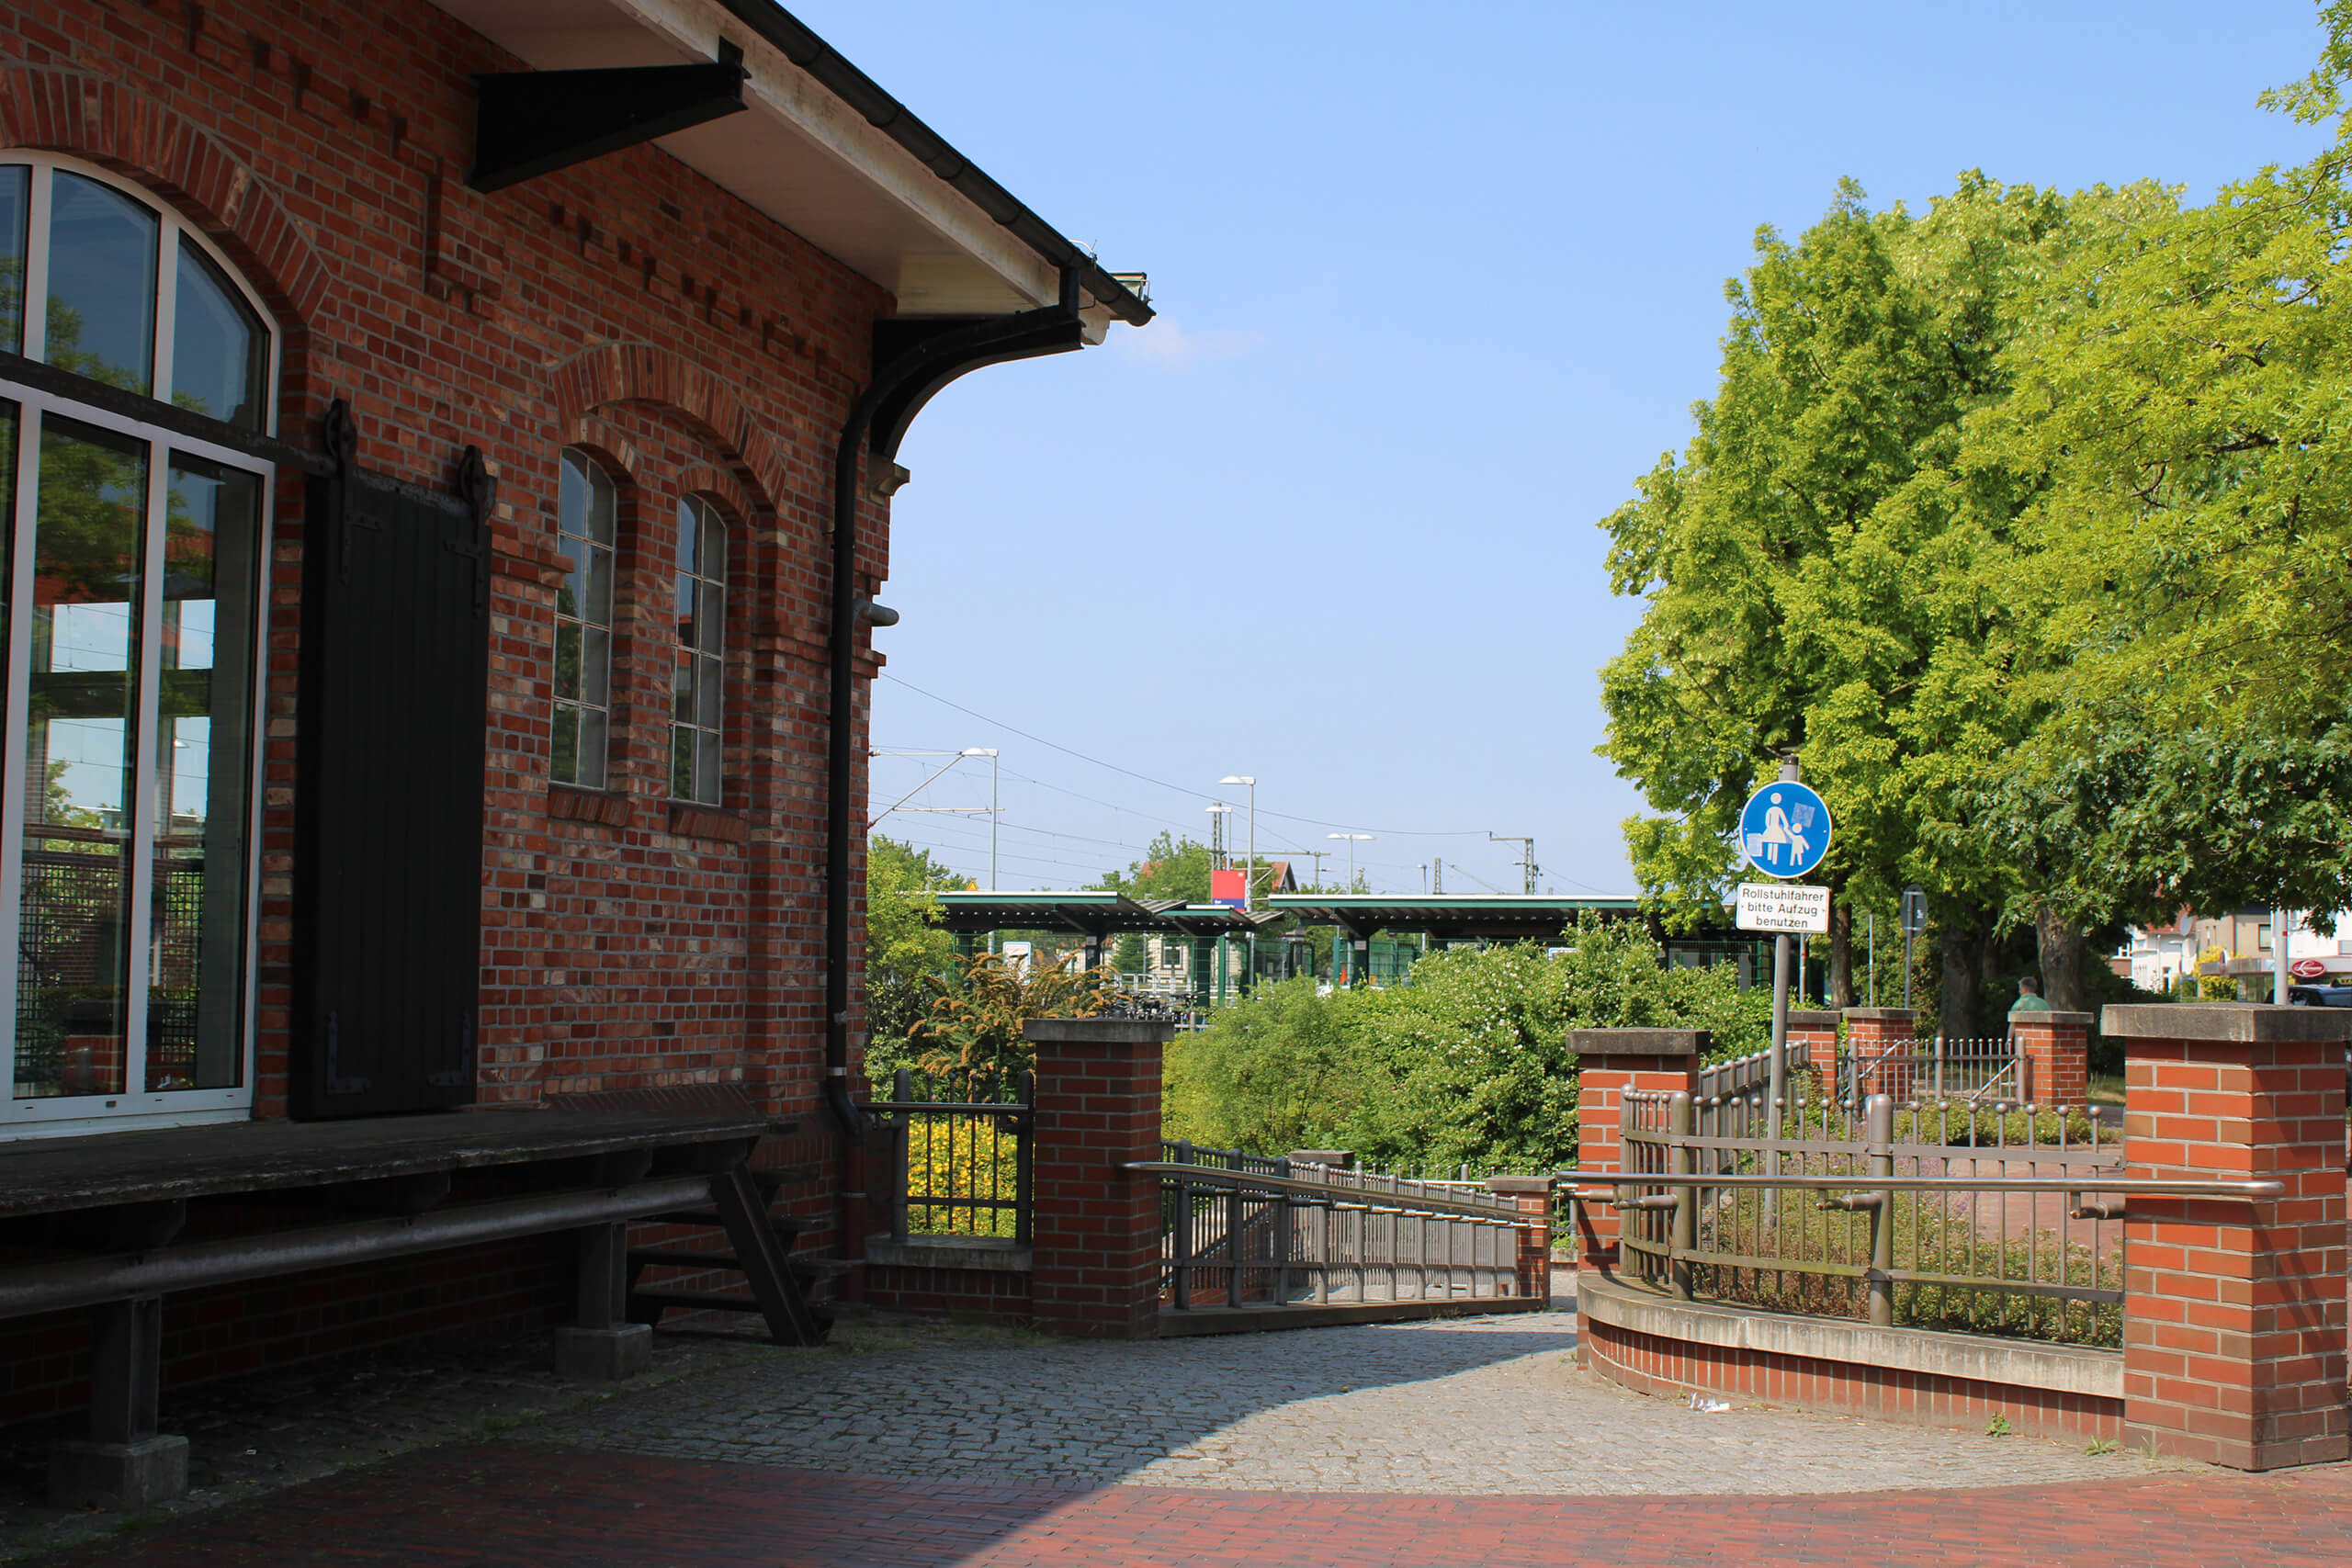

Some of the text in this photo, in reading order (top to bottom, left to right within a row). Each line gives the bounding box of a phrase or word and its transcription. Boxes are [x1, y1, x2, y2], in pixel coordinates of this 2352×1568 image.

[1743, 888, 1824, 901] Rollstuhlfahrer
[1747, 902, 1818, 917] bitte Aufzug
[1756, 915, 1808, 928] benutzen
